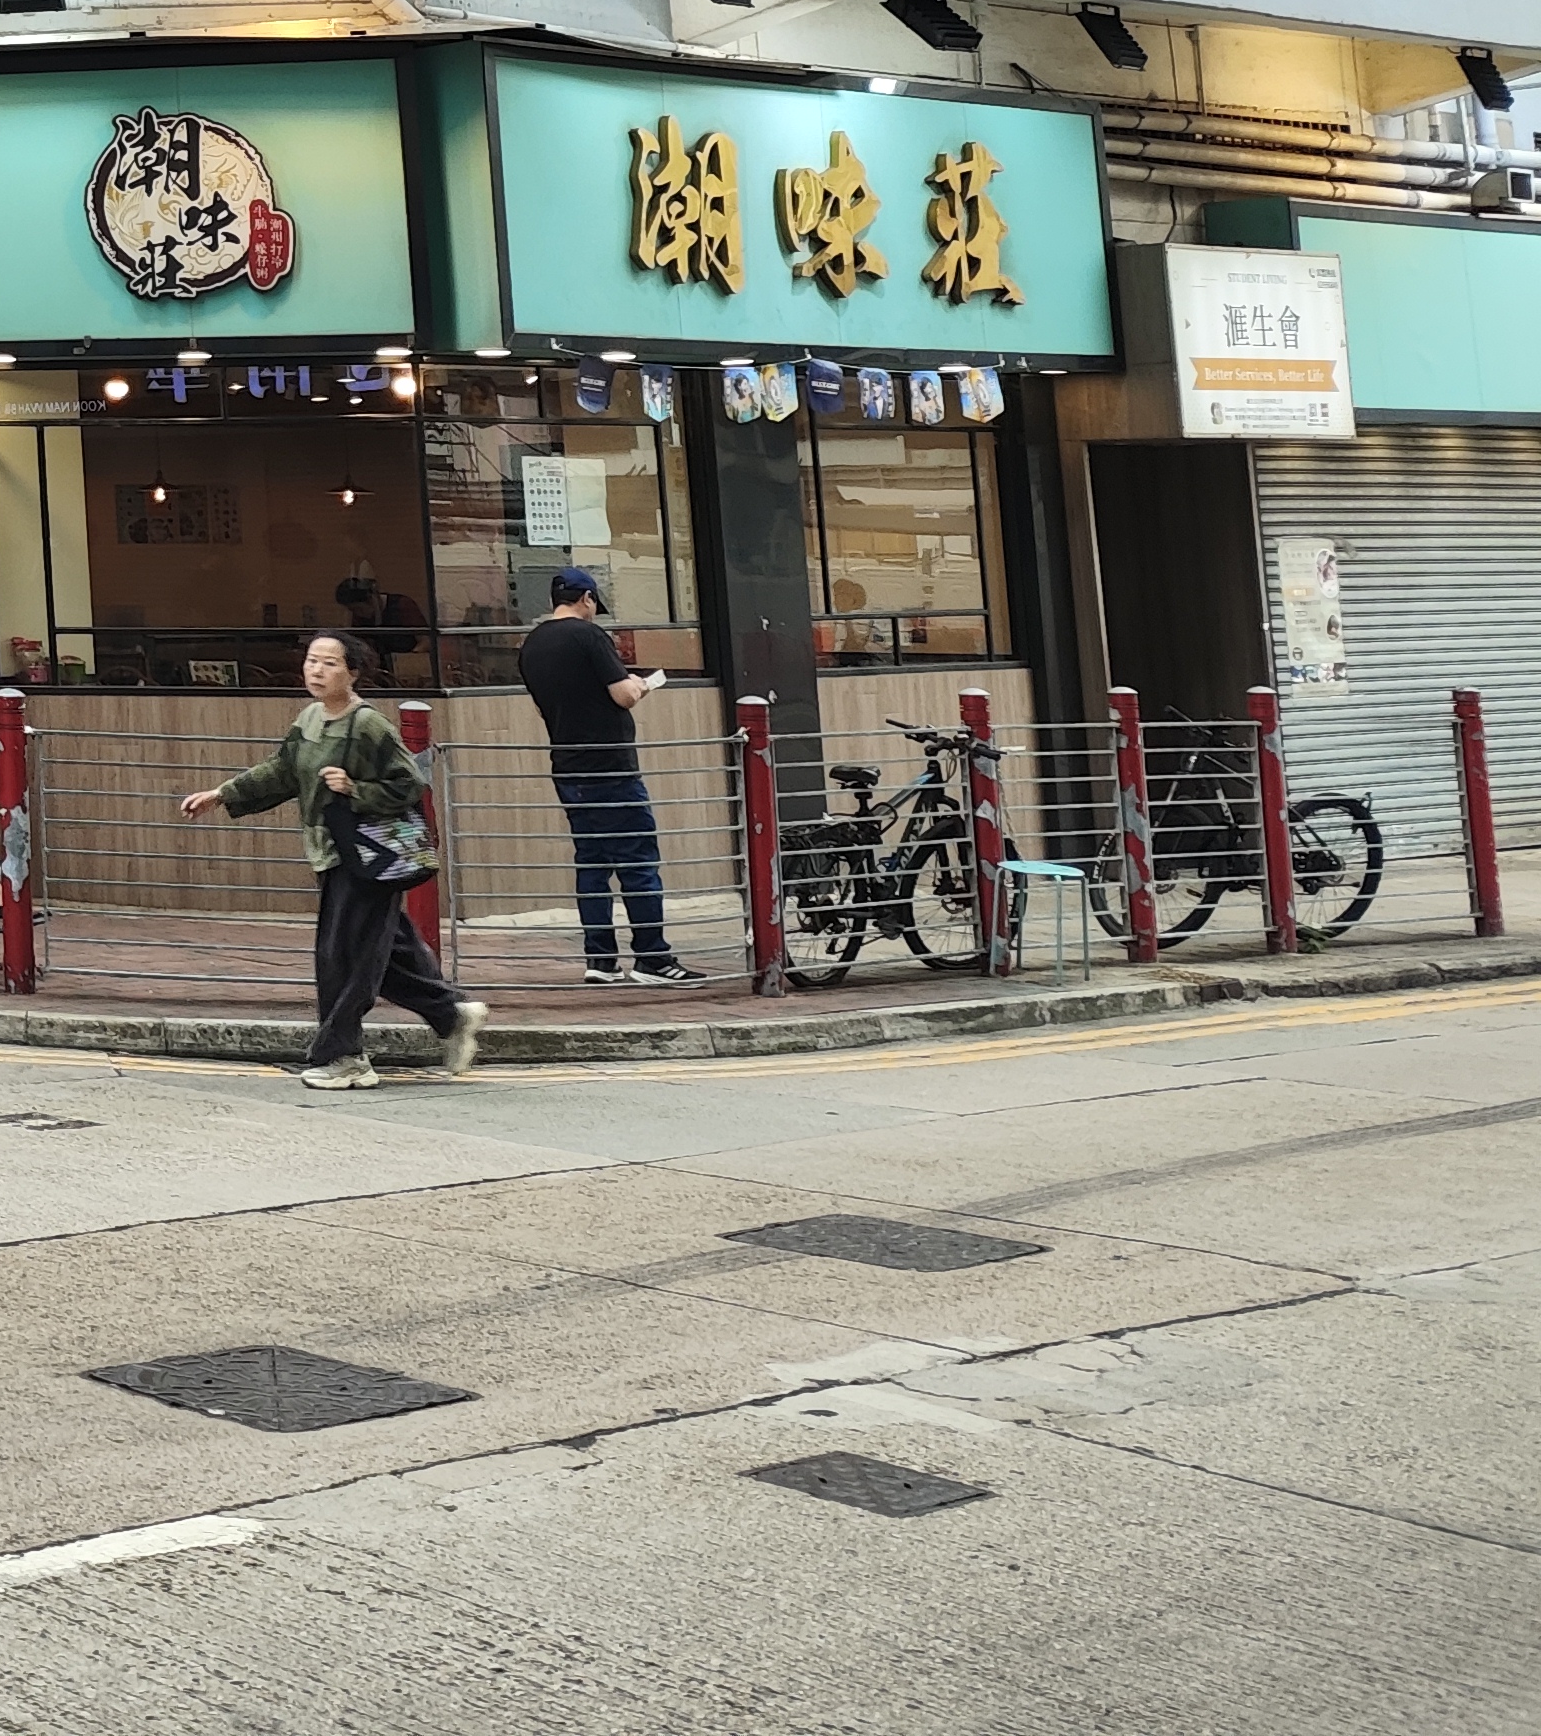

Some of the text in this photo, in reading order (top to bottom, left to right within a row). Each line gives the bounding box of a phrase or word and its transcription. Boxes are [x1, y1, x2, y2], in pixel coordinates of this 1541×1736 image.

[114, 108, 241, 296] 潮味莊
[630, 115, 1025, 306] 潮味莊
[1227, 272, 1288, 285] STUDENT LIVING
[1204, 367, 1325, 384] Better Services, Better Life
